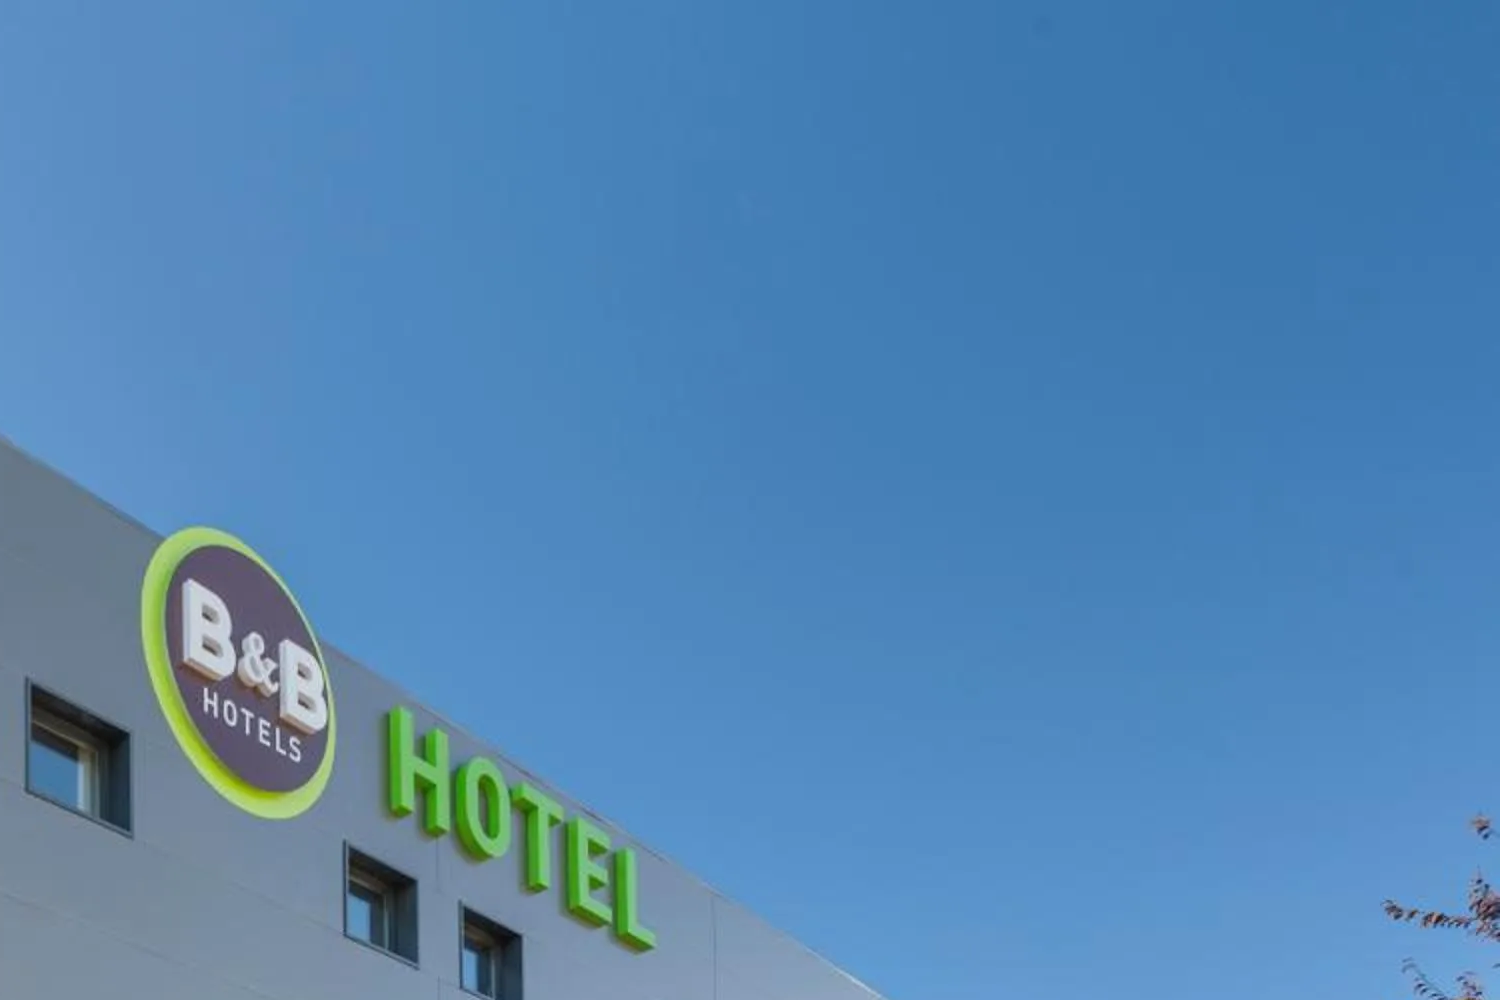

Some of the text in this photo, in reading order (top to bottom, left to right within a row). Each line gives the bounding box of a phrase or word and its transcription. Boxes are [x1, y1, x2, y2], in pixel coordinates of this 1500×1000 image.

[182, 578, 328, 735] B&B
[203, 687, 301, 763] HOTELS
[387, 705, 656, 952] HOTEL
